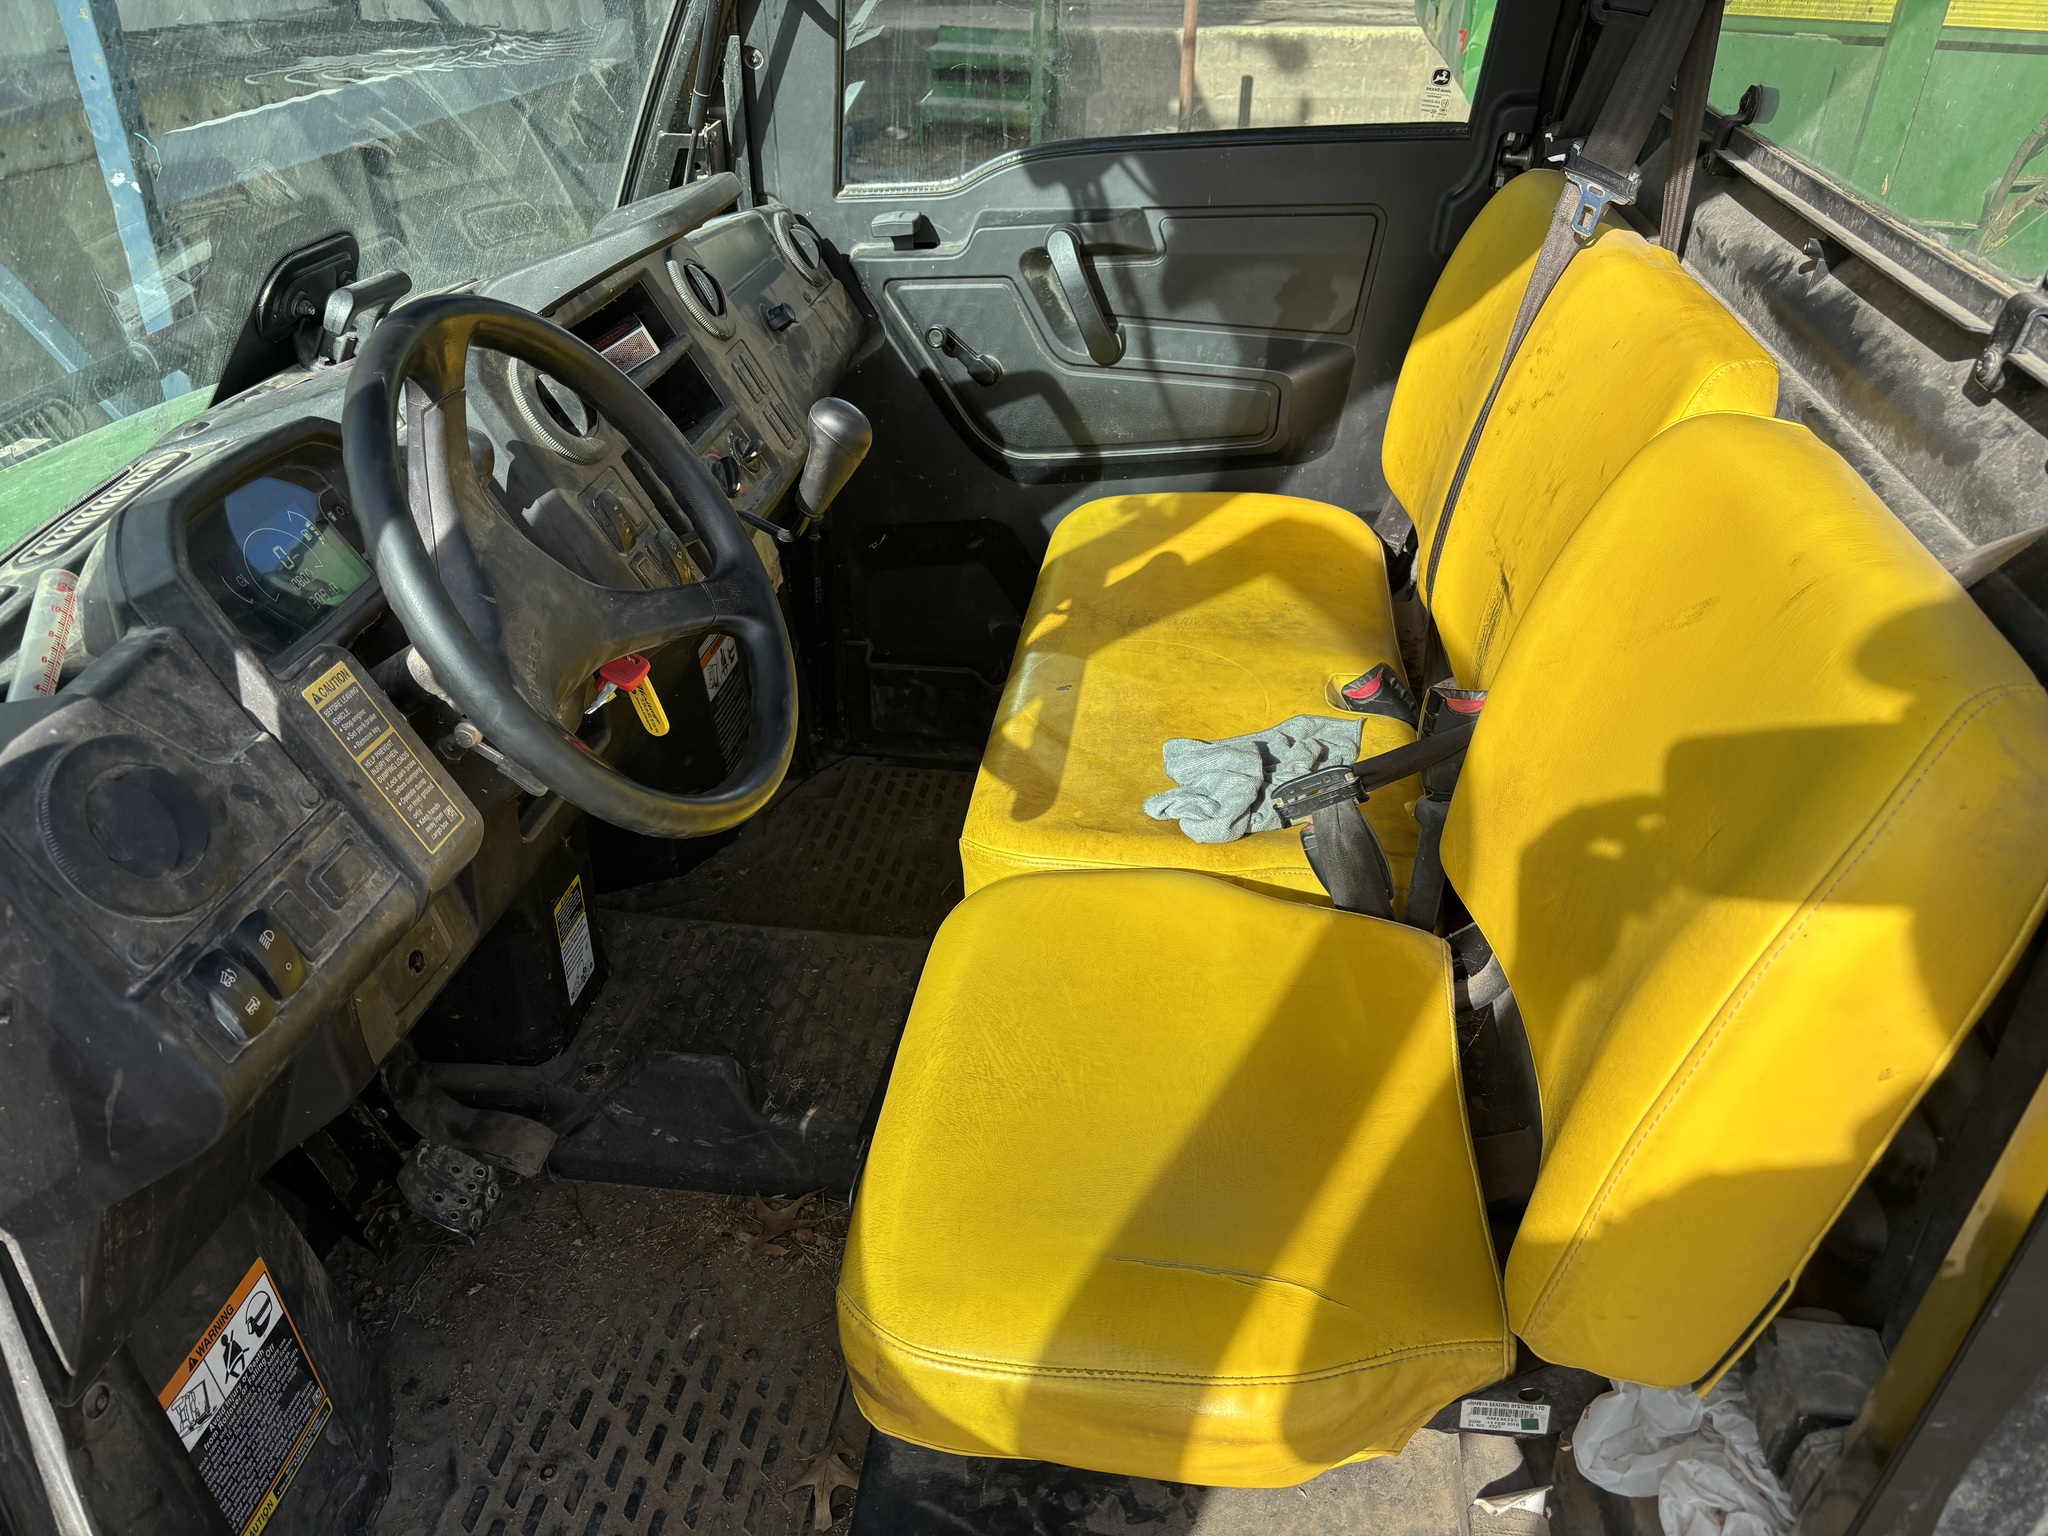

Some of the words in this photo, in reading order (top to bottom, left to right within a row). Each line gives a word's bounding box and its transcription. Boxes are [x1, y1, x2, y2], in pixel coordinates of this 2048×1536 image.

[317, 669, 351, 697] CAUTION
[323, 700, 343, 717] BEFORE
[340, 686, 359, 703] LEAVING
[341, 719, 354, 731] Stop
[351, 709, 367, 724] engine
[348, 729, 357, 738] Set
[355, 722, 367, 733] park
[364, 712, 377, 724] brake
[356, 731, 373, 747] Remove
[371, 725, 381, 735] key
[364, 755, 377, 768] HELP
[374, 740, 394, 758] PREVENT
[370, 760, 386, 775] INJURY
[384, 749, 398, 762] WHEN
[377, 763, 397, 783] DUMPING
[394, 751, 409, 766] LOADS
[387, 776, 398, 787] Lock
[396, 768, 407, 780] park
[404, 759, 416, 771] brake
[393, 780, 407, 795] before
[404, 766, 423, 785] dumping
[400, 787, 417, 805] Operate
[414, 777, 427, 791] dump
[411, 794, 422, 806] level
[420, 782, 435, 799] ground
[412, 808, 423, 820] only
[418, 812, 431, 826] Keep
[427, 801, 440, 815] hands
[425, 821, 437, 834] away
[433, 811, 444, 822] from
[431, 827, 444, 841] cargo
[440, 819, 448, 829] box
[196, 1303, 234, 1357] WARNING
[204, 1429, 218, 1450] from
[218, 1395, 241, 1429] Rollover
[242, 1386, 248, 1395] or
[248, 1357, 267, 1386] Falling
[266, 1344, 275, 1357] Off
[209, 1407, 225, 1431] Avoid
[225, 1382, 242, 1408] Injury
[242, 1373, 248, 1383] or
[248, 1349, 264, 1372] Death
[249, 1500, 273, 1536] AUTION
